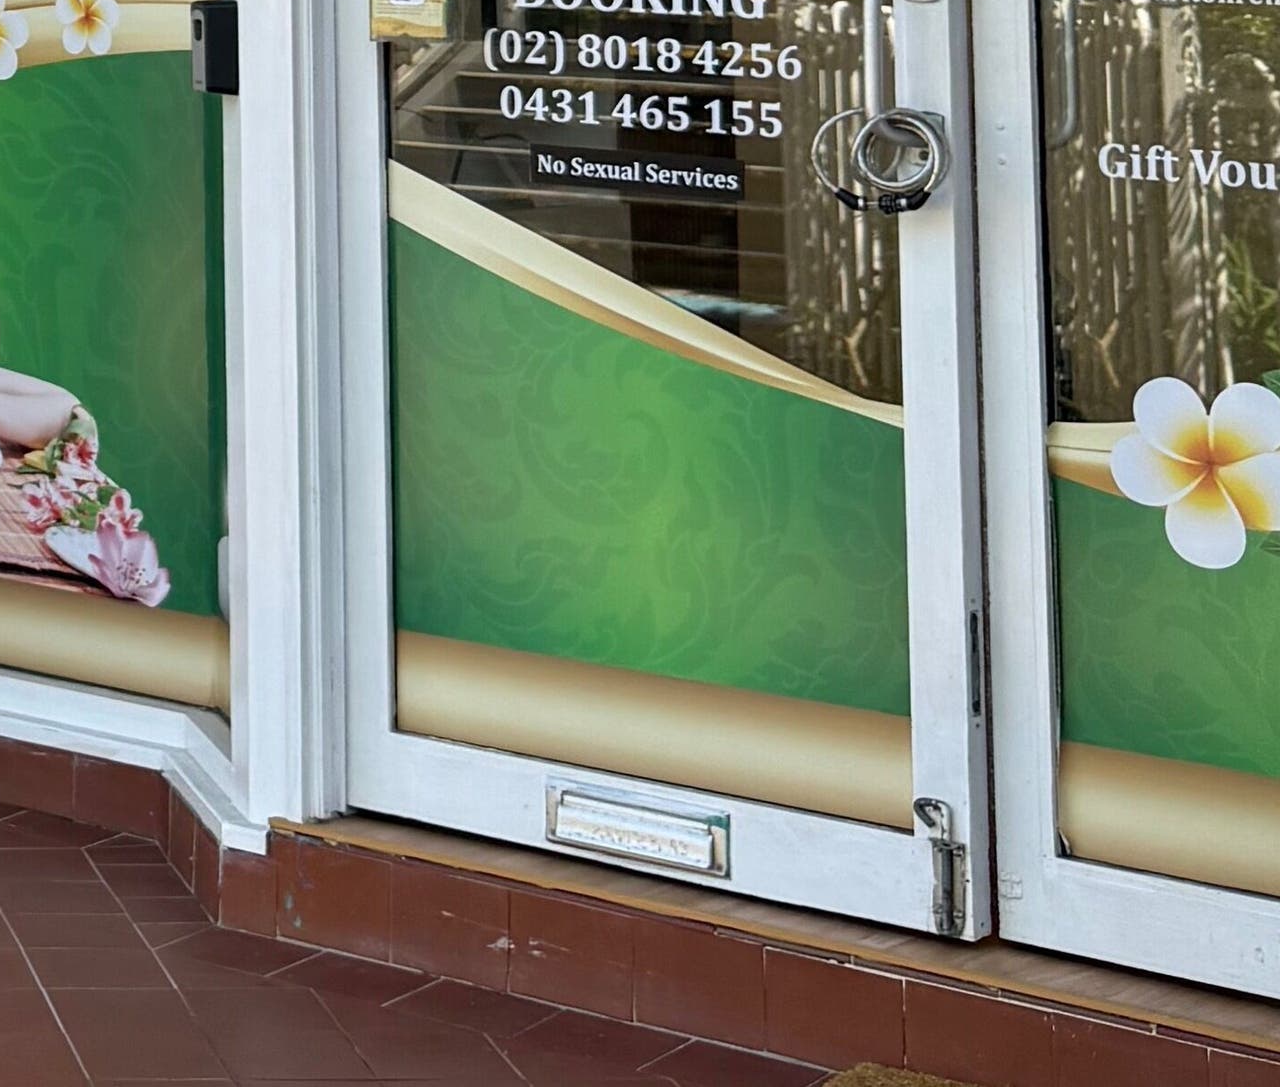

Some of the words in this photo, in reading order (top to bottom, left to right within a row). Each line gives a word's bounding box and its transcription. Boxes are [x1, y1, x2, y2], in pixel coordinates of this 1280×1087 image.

[483, 27, 566, 75] (02)
[577, 34, 683, 73] 8018
[691, 41, 803, 80] 4256
[499, 84, 601, 126] 0431
[611, 95, 690, 131] 465
[703, 100, 783, 139] 155
[537, 154, 565, 174] No
[571, 157, 640, 181] Sexual
[645, 162, 738, 191] Services
[1098, 143, 1180, 183] Gift
[1190, 149, 1279, 190] Vou
